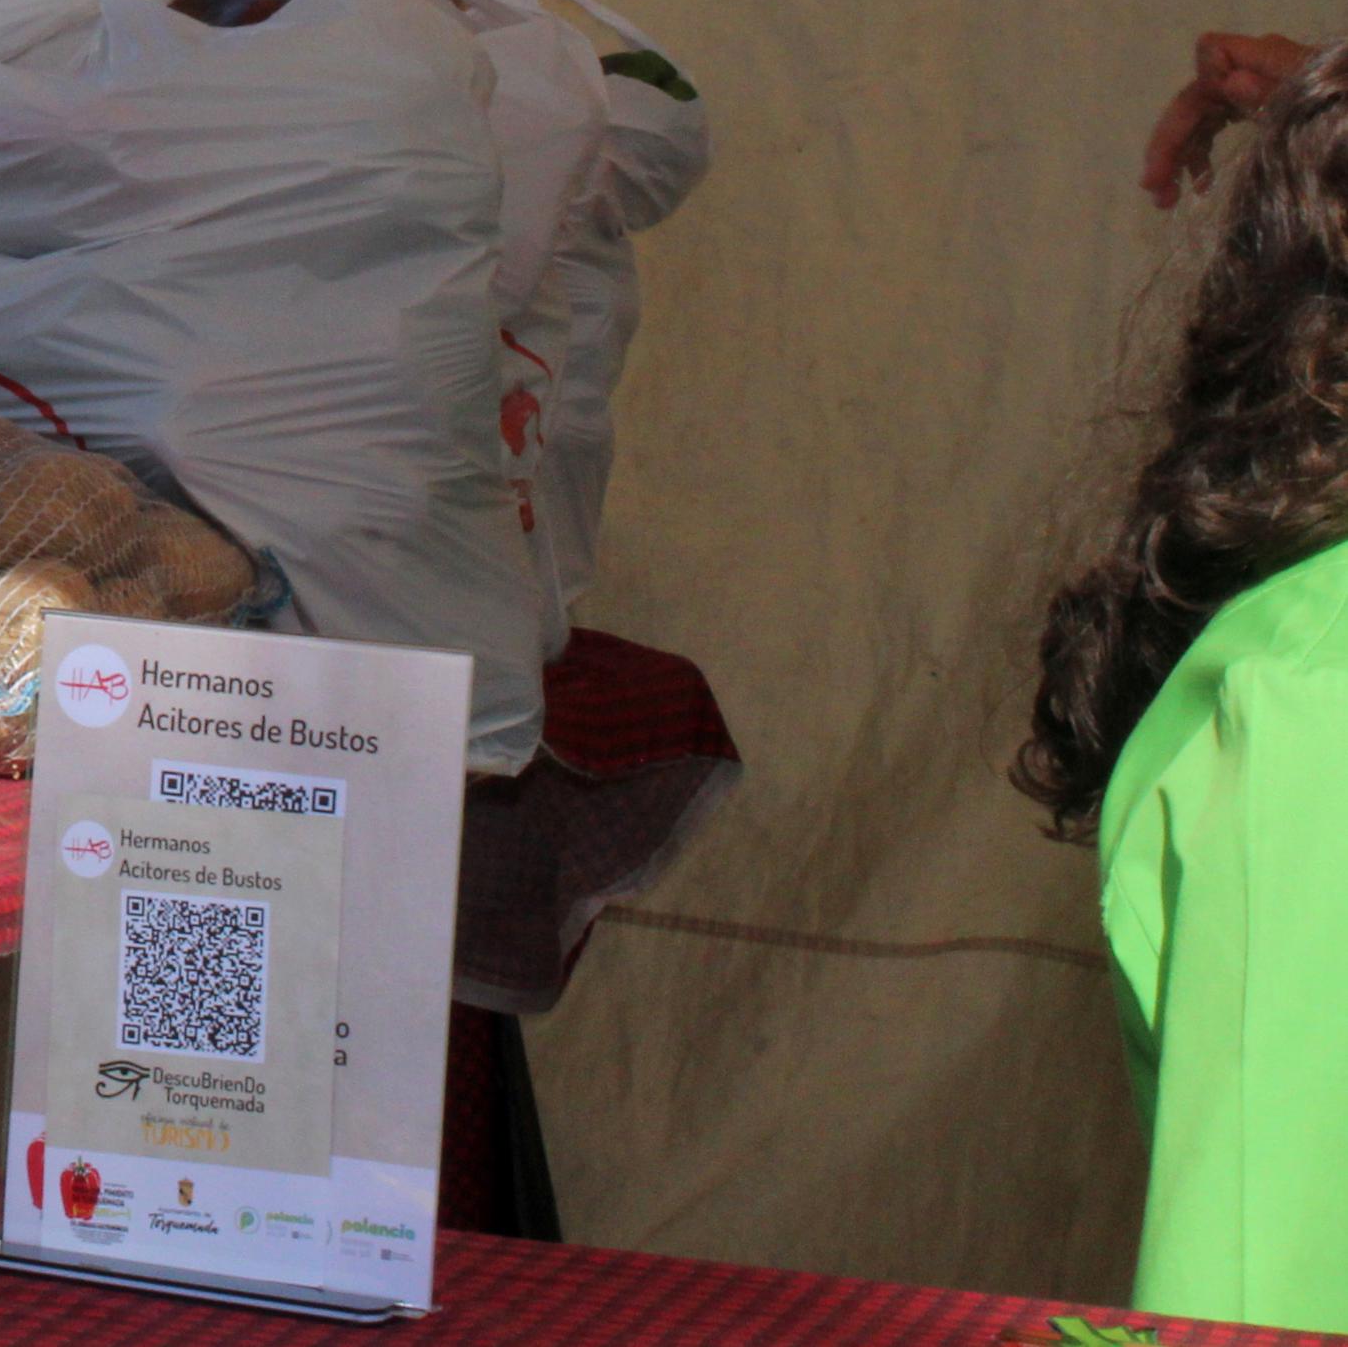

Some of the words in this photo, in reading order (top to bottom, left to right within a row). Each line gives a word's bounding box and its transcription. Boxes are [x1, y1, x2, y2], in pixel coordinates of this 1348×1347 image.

[140, 658, 274, 699] Hermanos
[137, 702, 243, 740] Acitores
[249, 715, 282, 744] de
[289, 719, 379, 755] Bustos
[119, 828, 211, 855] Hermanos
[118, 858, 191, 883] Acitores
[194, 865, 218, 886] de
[222, 868, 282, 891] Bustos
[164, 1086, 265, 1114] Torquemada
